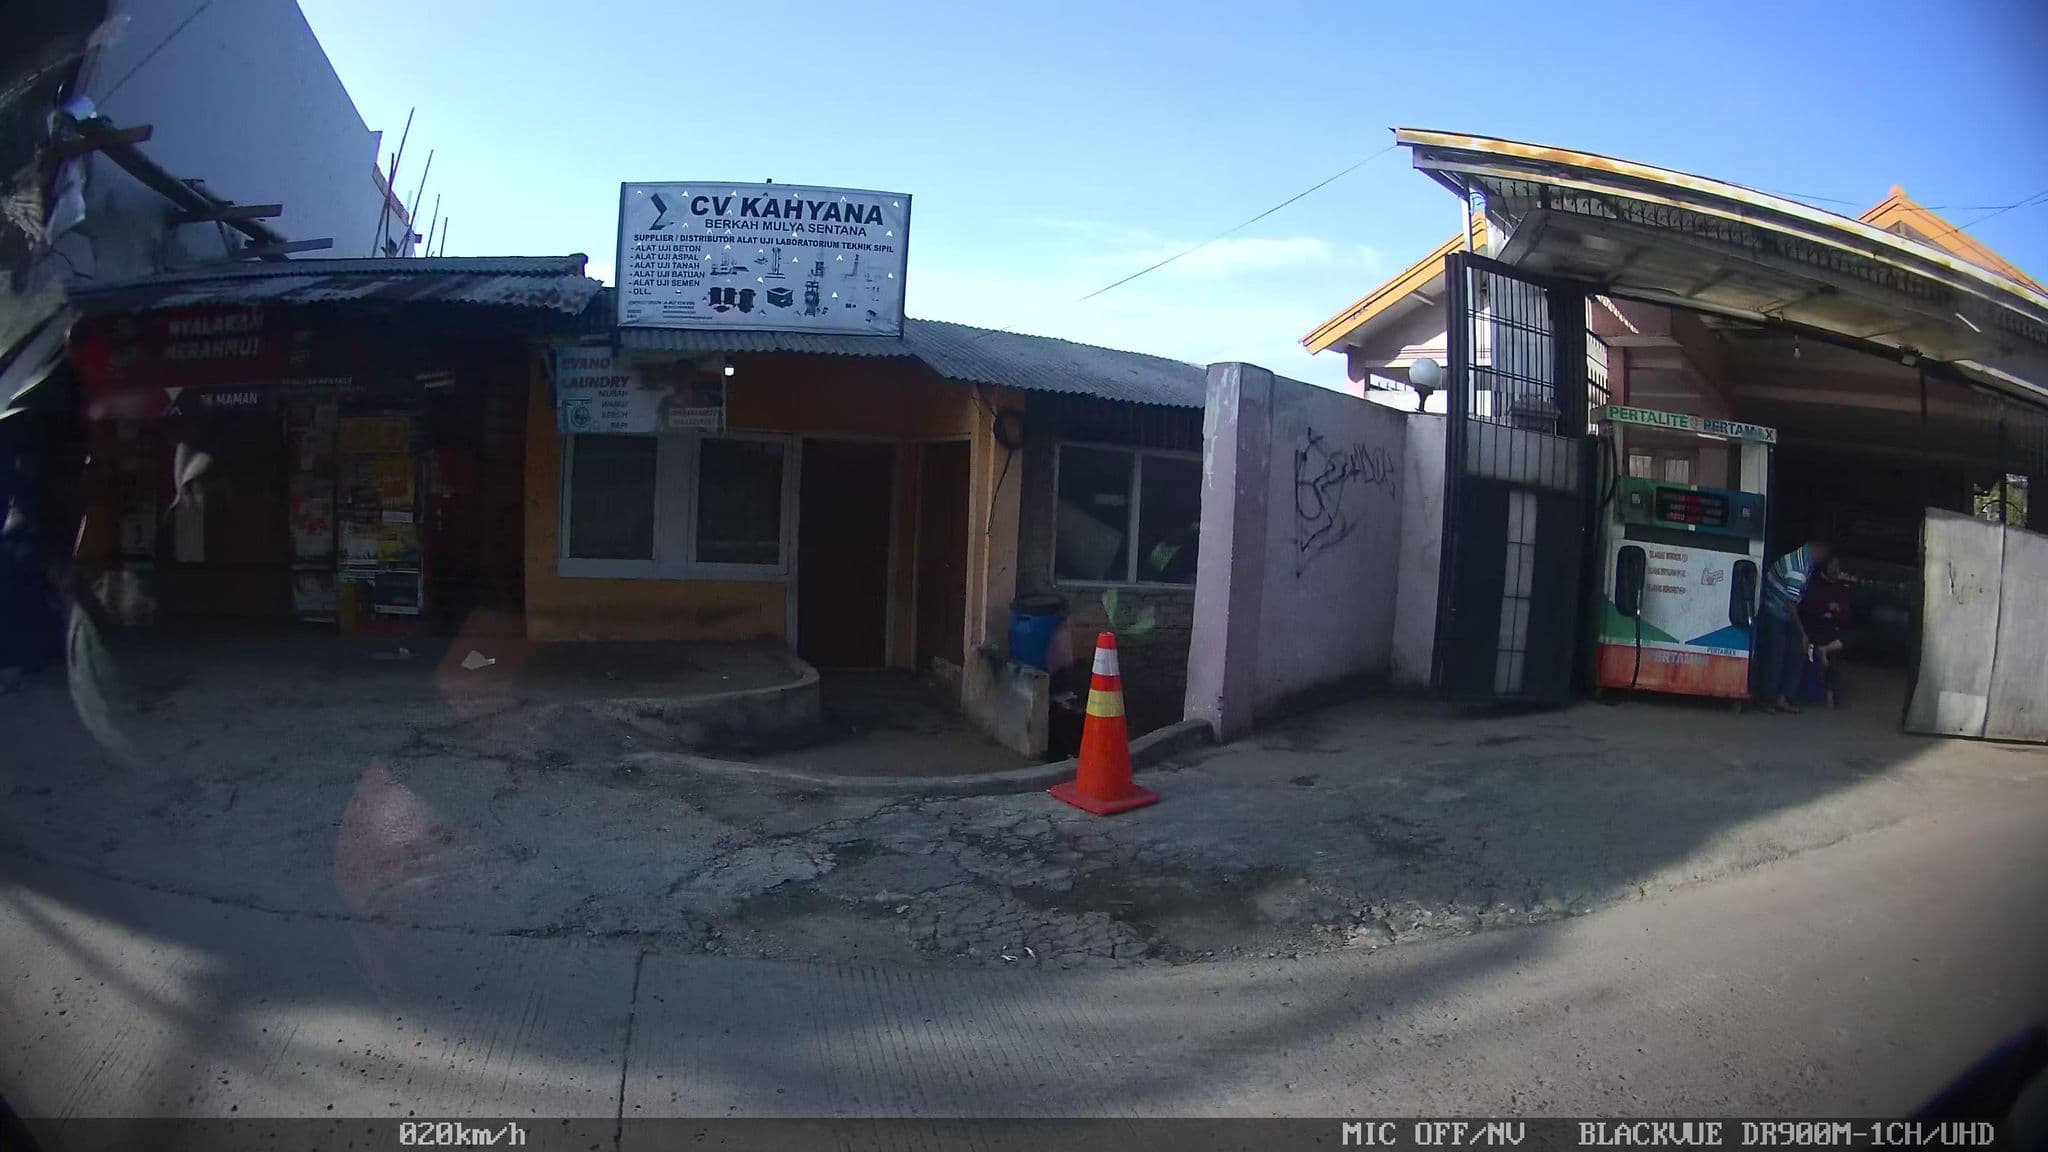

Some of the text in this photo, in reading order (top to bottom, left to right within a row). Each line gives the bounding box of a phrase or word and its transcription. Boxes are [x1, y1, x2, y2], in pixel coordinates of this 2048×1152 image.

[691, 195, 884, 226] CV KAHYANA
[705, 219, 867, 237] BERKAH MULYA SENTANA
[634, 235, 674, 243] SUPPLIER
[680, 235, 735, 244] DISTRIBUTOR
[737, 236, 758, 244] ALAT
[760, 237, 774, 245] UJI
[775, 238, 840, 249] LABORATORIUM
[842, 242, 872, 251] TEKNIK
[873, 245, 894, 253] SIPIL
[672, 262, 700, 270] TANAH
[561, 376, 630, 388] LAUNDRY
[216, 392, 257, 406] MAMAN
[1609, 407, 1689, 428] PERTALITE
